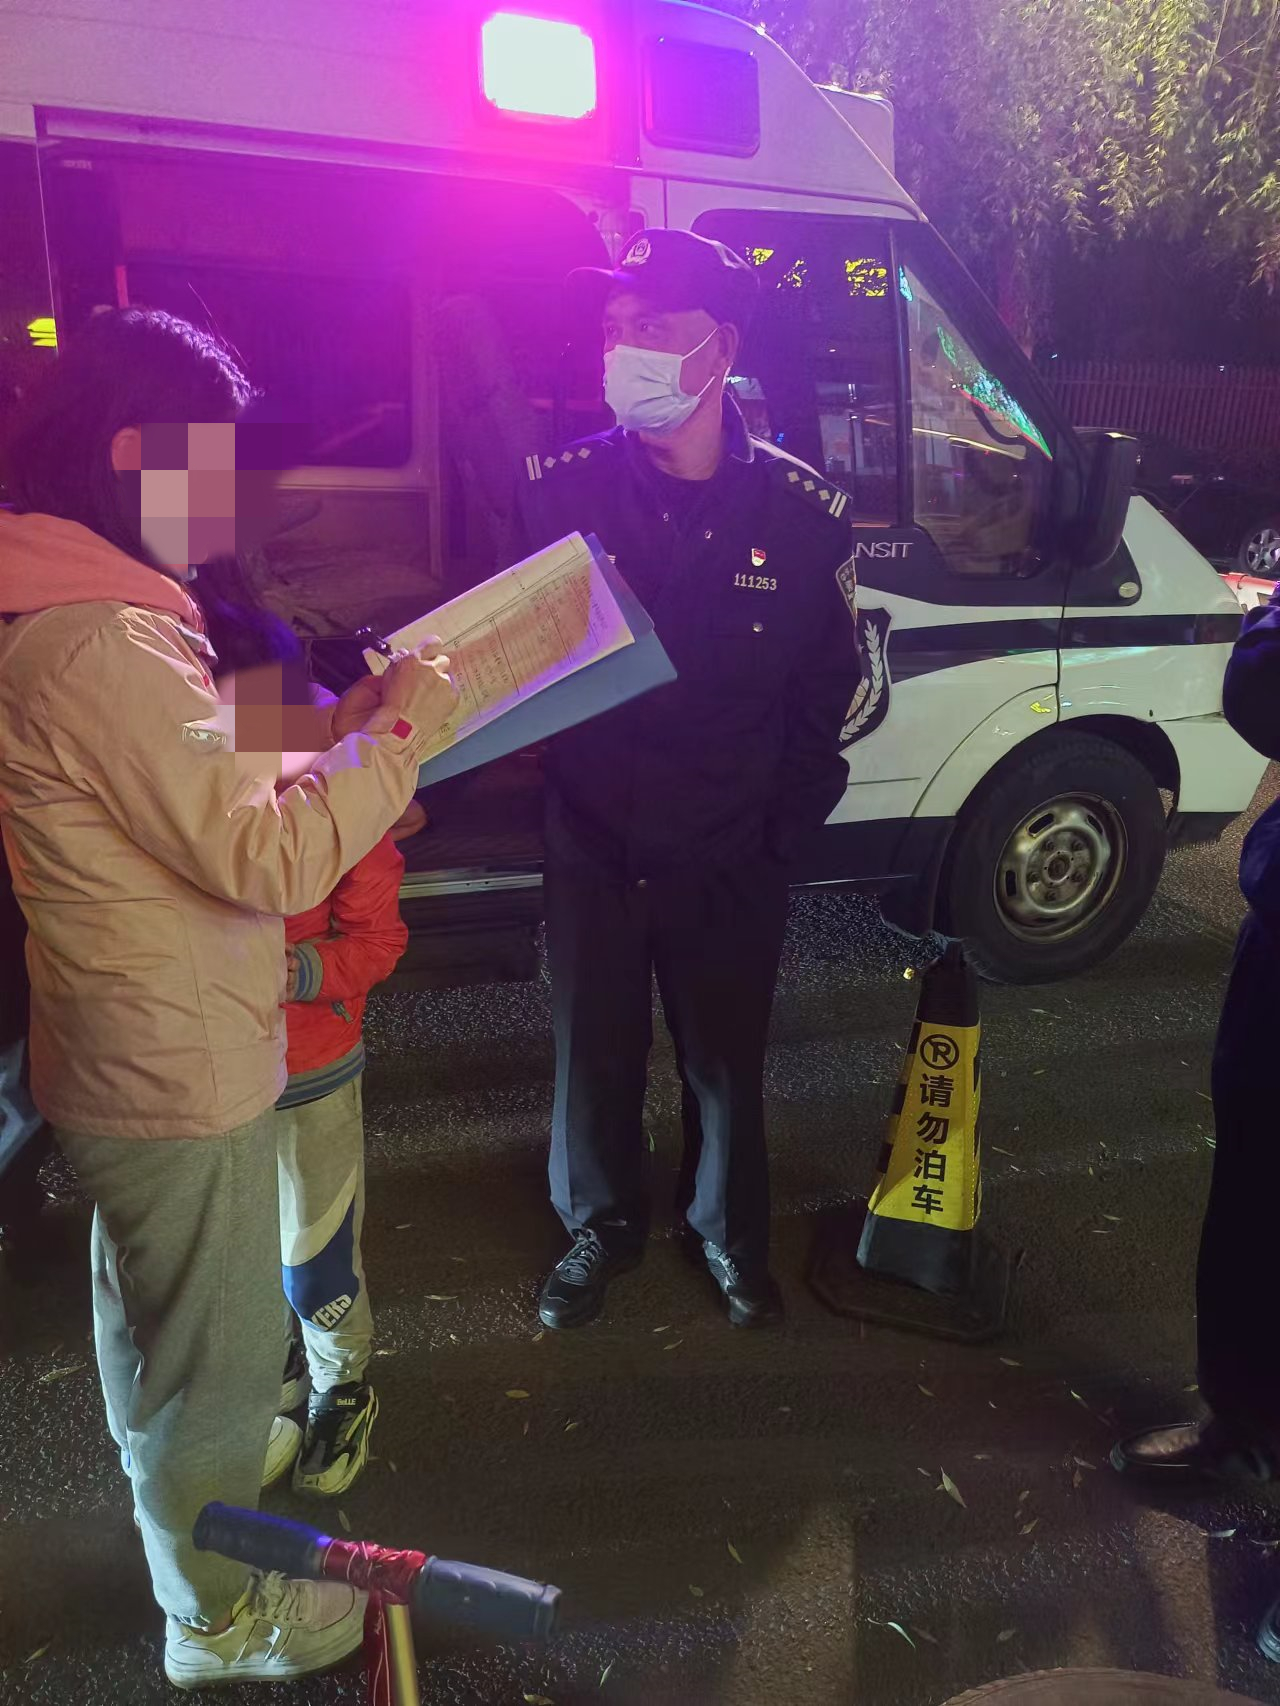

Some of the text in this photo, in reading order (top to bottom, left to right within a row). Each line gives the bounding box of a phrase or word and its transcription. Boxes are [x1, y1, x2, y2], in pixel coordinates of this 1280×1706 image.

[853, 541, 914, 558] NSIT
[733, 572, 777, 591] 111253
[911, 1073, 954, 1215] 请勿泊车
